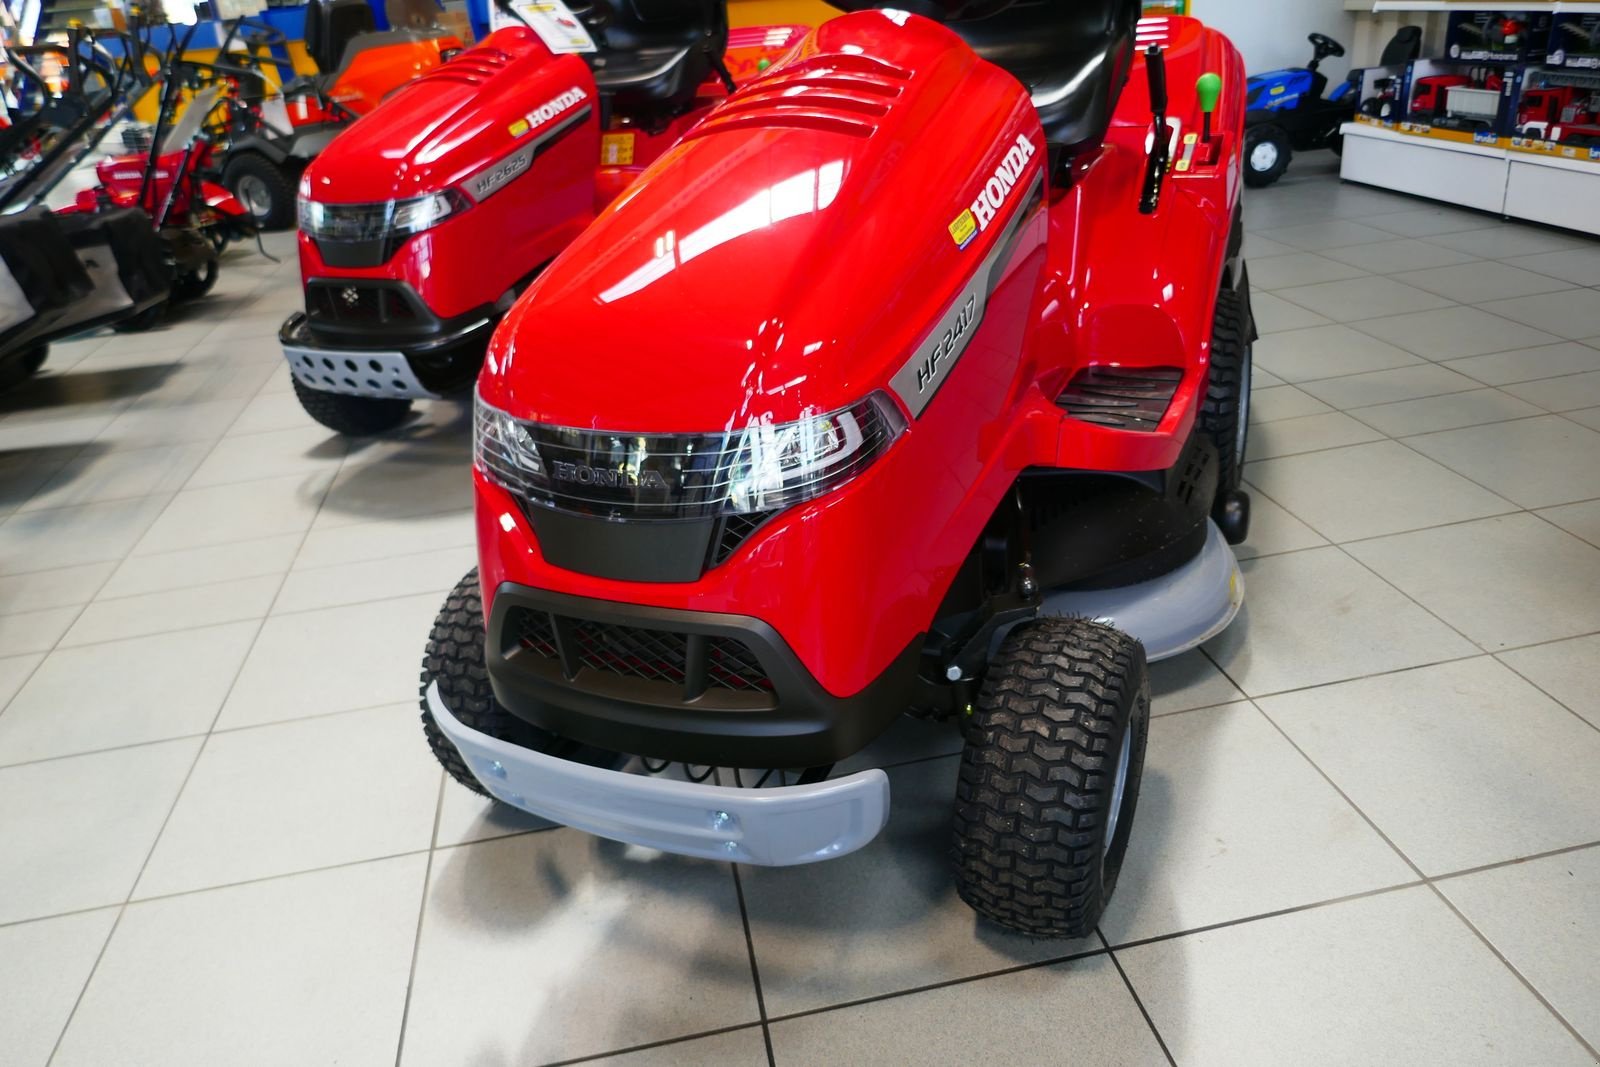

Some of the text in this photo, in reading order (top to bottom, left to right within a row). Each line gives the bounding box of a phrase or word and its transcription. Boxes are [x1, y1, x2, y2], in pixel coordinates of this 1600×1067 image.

[525, 86, 587, 129] HONDA
[970, 133, 1036, 232] HONDA
[552, 460, 670, 489] HONDA
